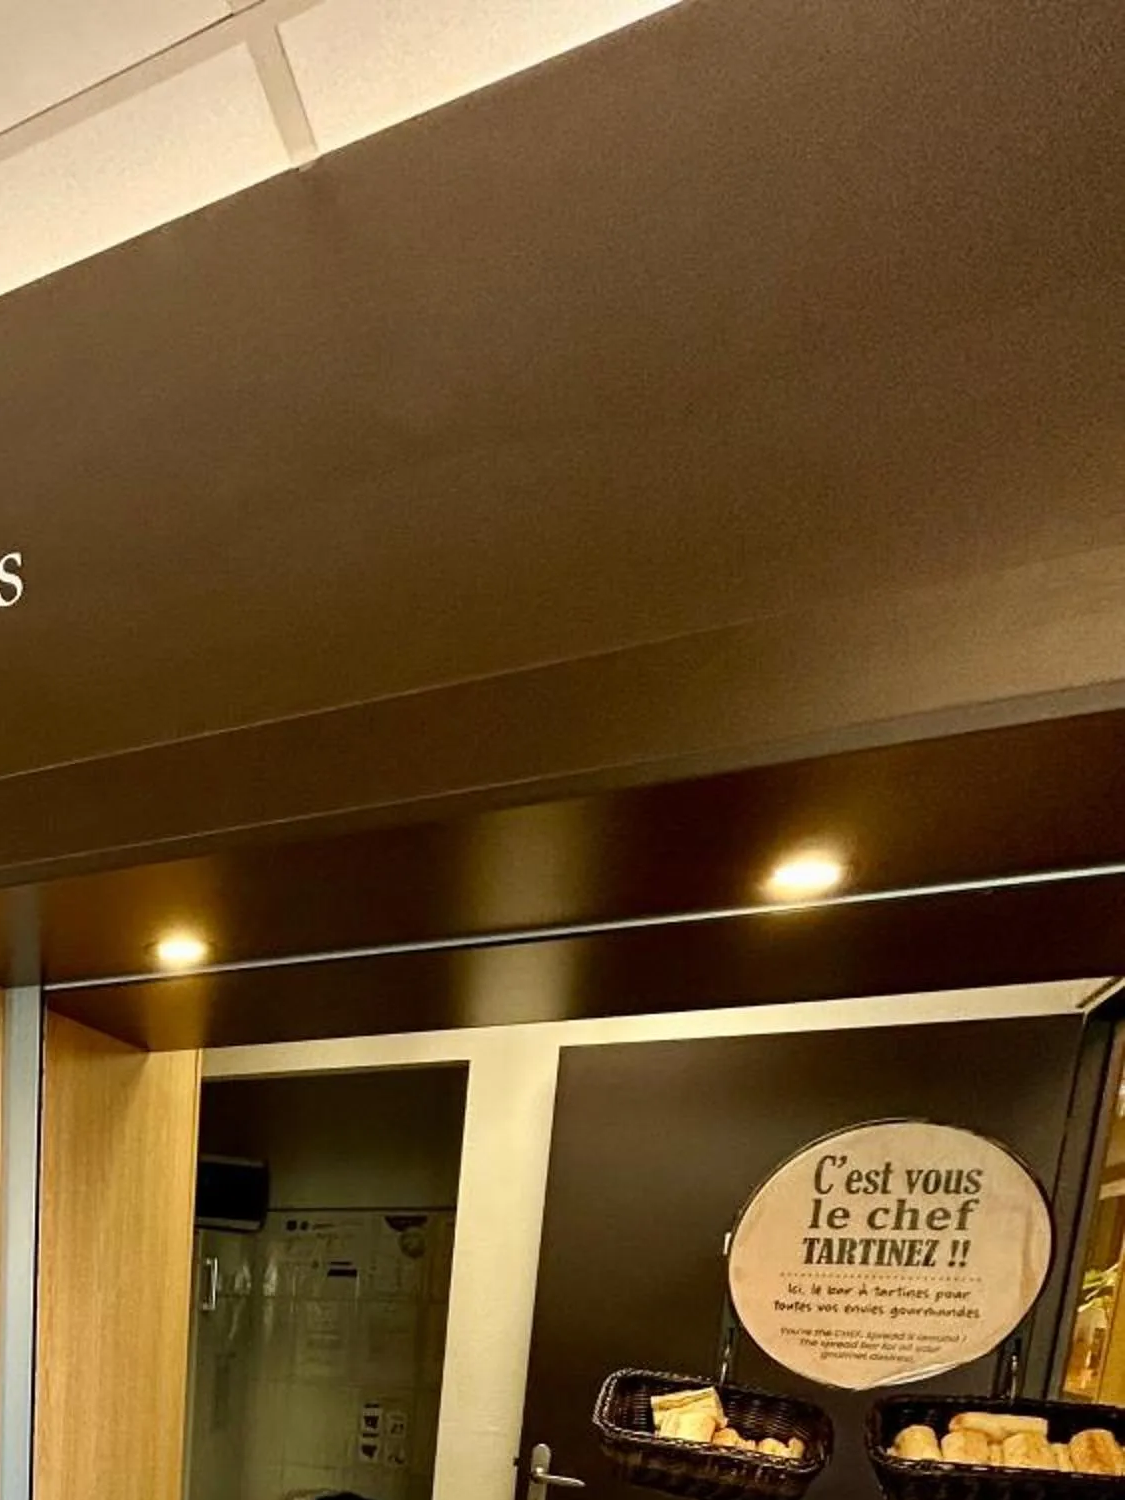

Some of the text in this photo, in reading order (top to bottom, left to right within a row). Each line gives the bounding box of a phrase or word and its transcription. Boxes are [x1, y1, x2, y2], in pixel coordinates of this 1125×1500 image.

[813, 1154, 984, 1196] C'est vous
[808, 1198, 980, 1231] le chef
[802, 1237, 972, 1268] TARTINEZ !!
